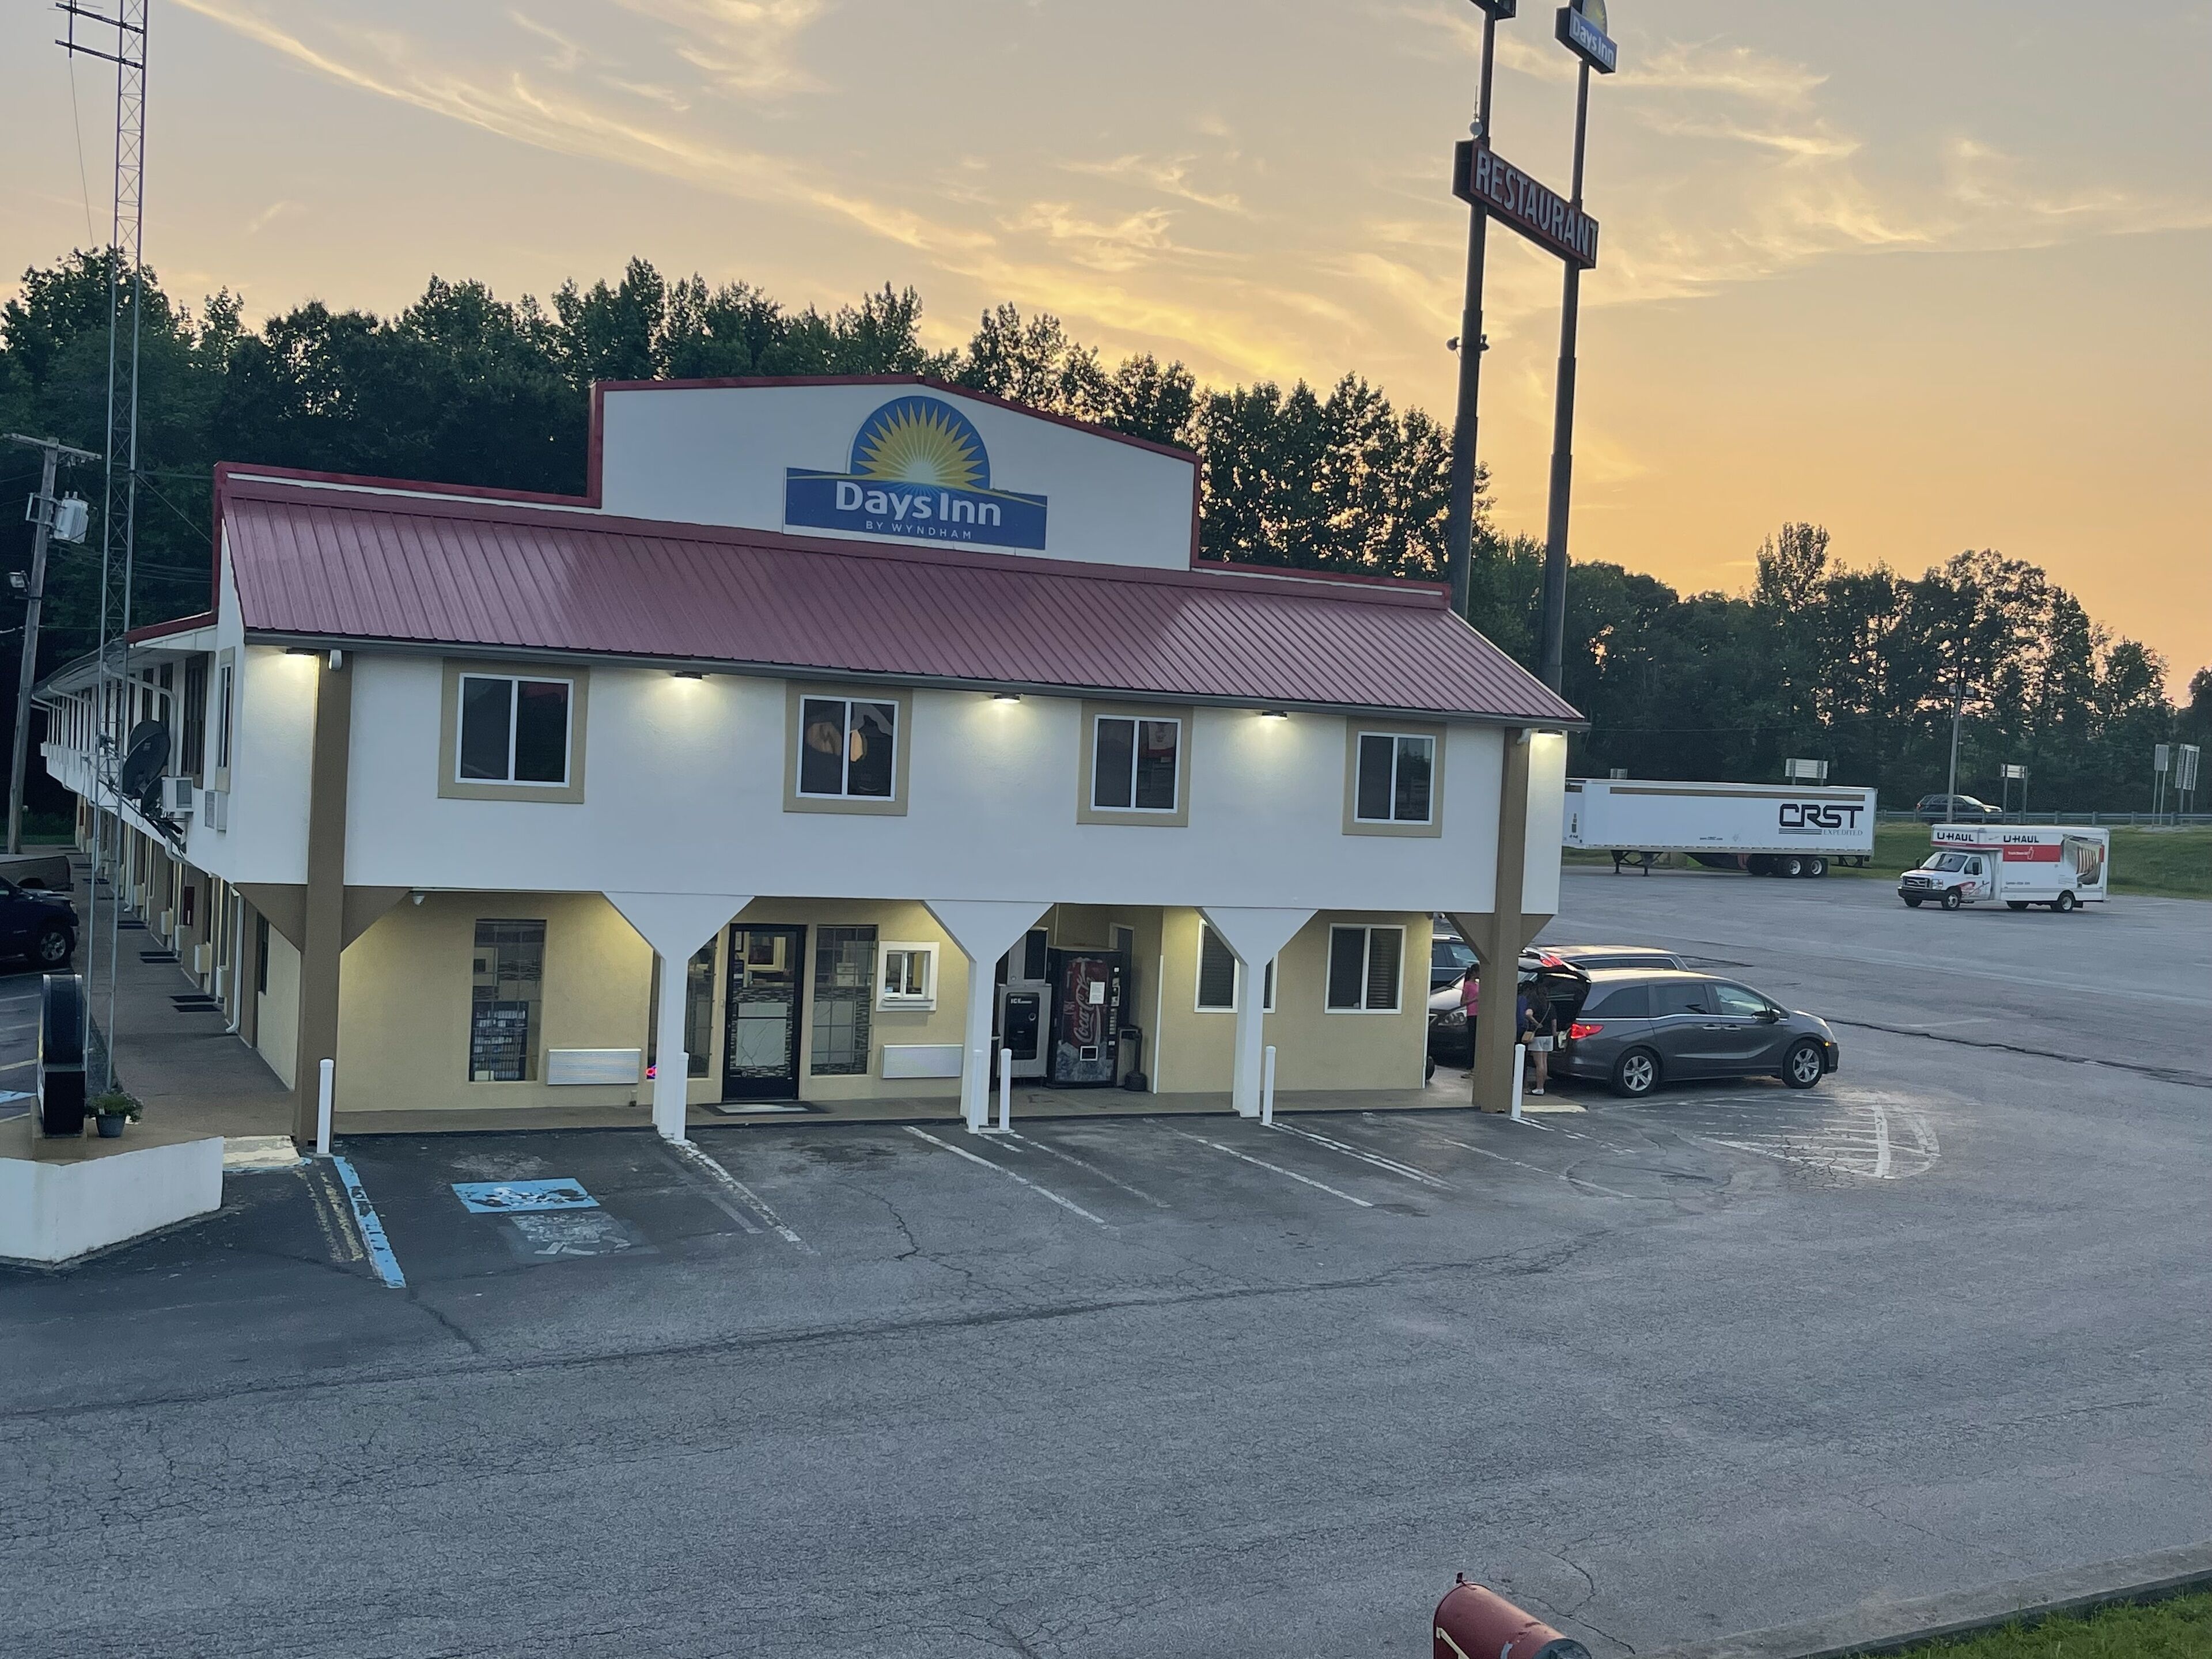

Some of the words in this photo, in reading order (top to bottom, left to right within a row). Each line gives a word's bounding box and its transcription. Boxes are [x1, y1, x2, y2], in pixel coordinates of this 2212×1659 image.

[1573, 14, 1597, 51] Days
[1598, 36, 1615, 66] Inn
[1475, 148, 1599, 261] RESTAURANT
[835, 481, 933, 521] Days
[940, 493, 1001, 527] Inn
[866, 521, 884, 531] BY
[892, 524, 972, 540] WYNDHAM
[1779, 804, 1864, 828] CRST
[1937, 832, 1974, 842] U-HAUL
[2003, 835, 2040, 843] U-HAUL
